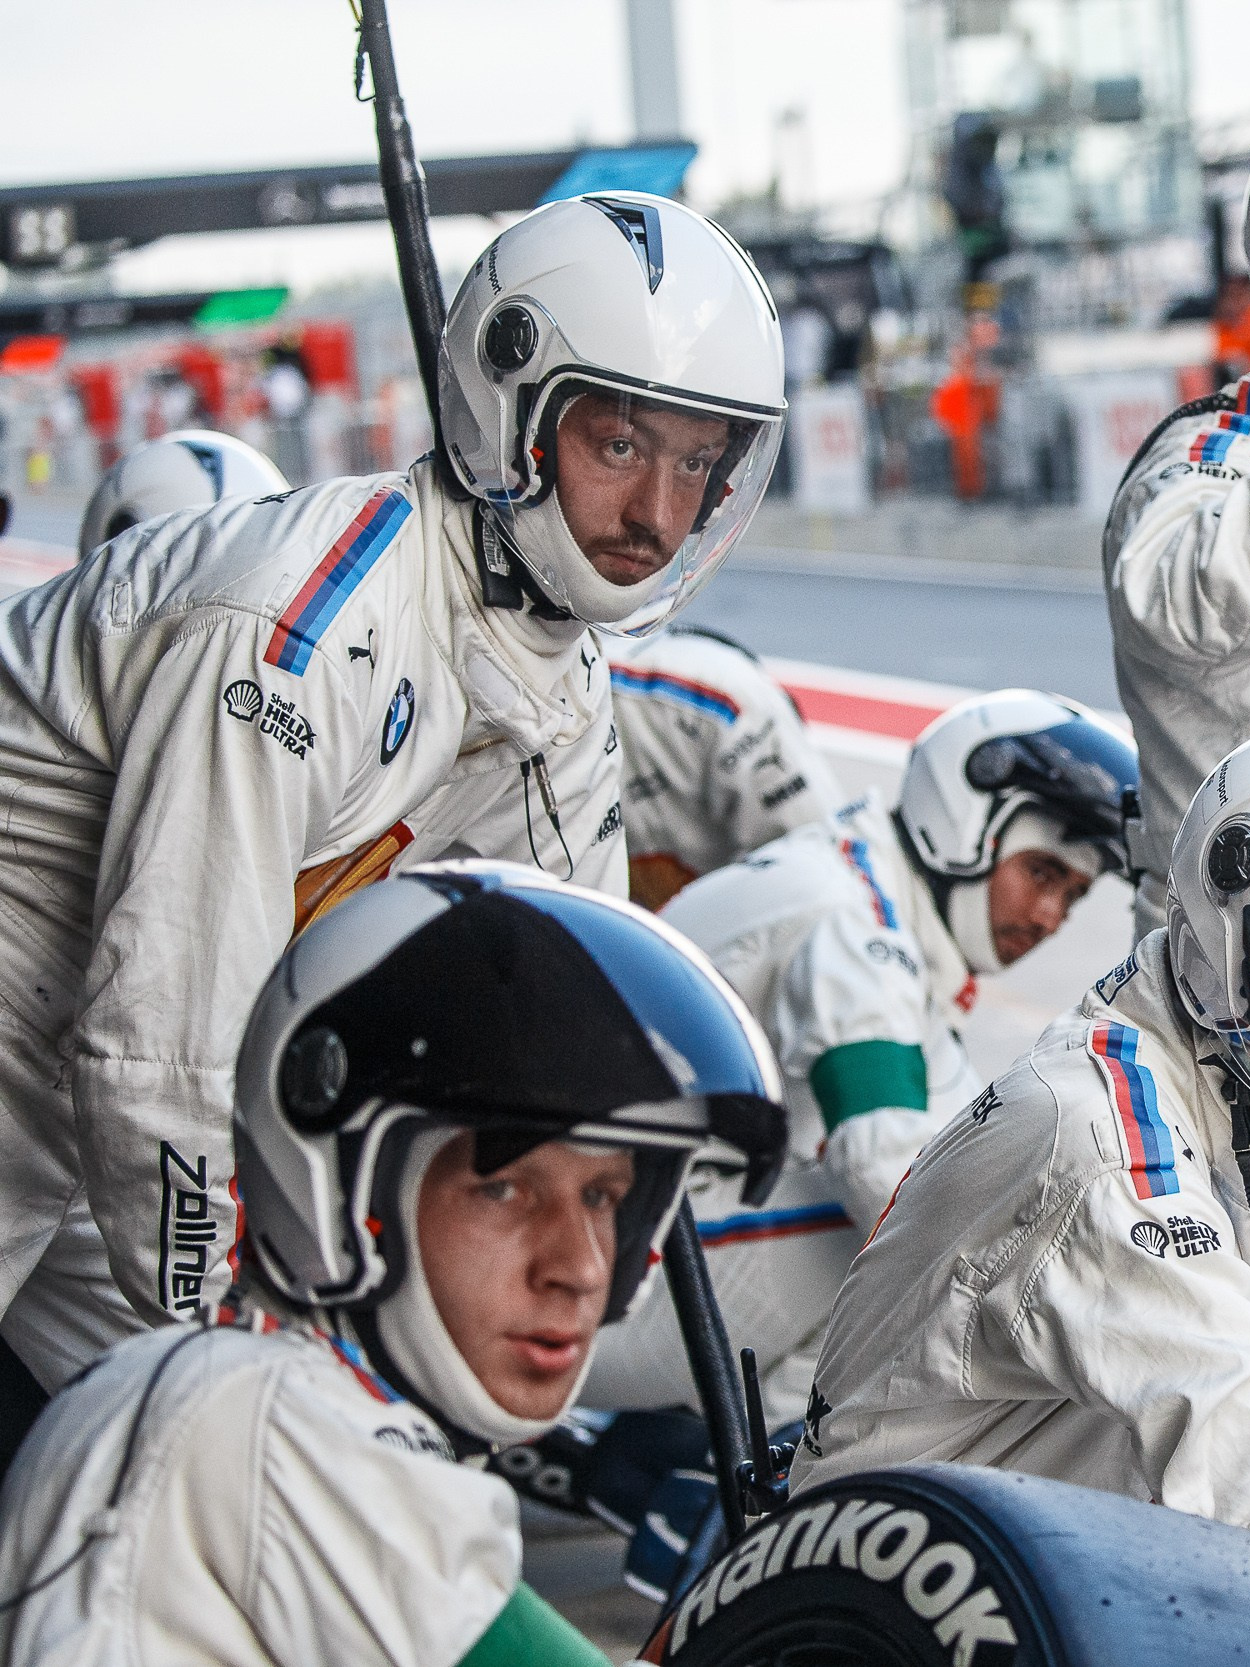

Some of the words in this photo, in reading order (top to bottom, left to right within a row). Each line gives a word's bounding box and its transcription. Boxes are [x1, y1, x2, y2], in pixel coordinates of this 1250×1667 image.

[270, 692, 296, 714] Shell
[260, 718, 307, 761] ULTRA
[264, 702, 317, 749] HELIX
[1175, 1239, 1218, 1258] ULT
